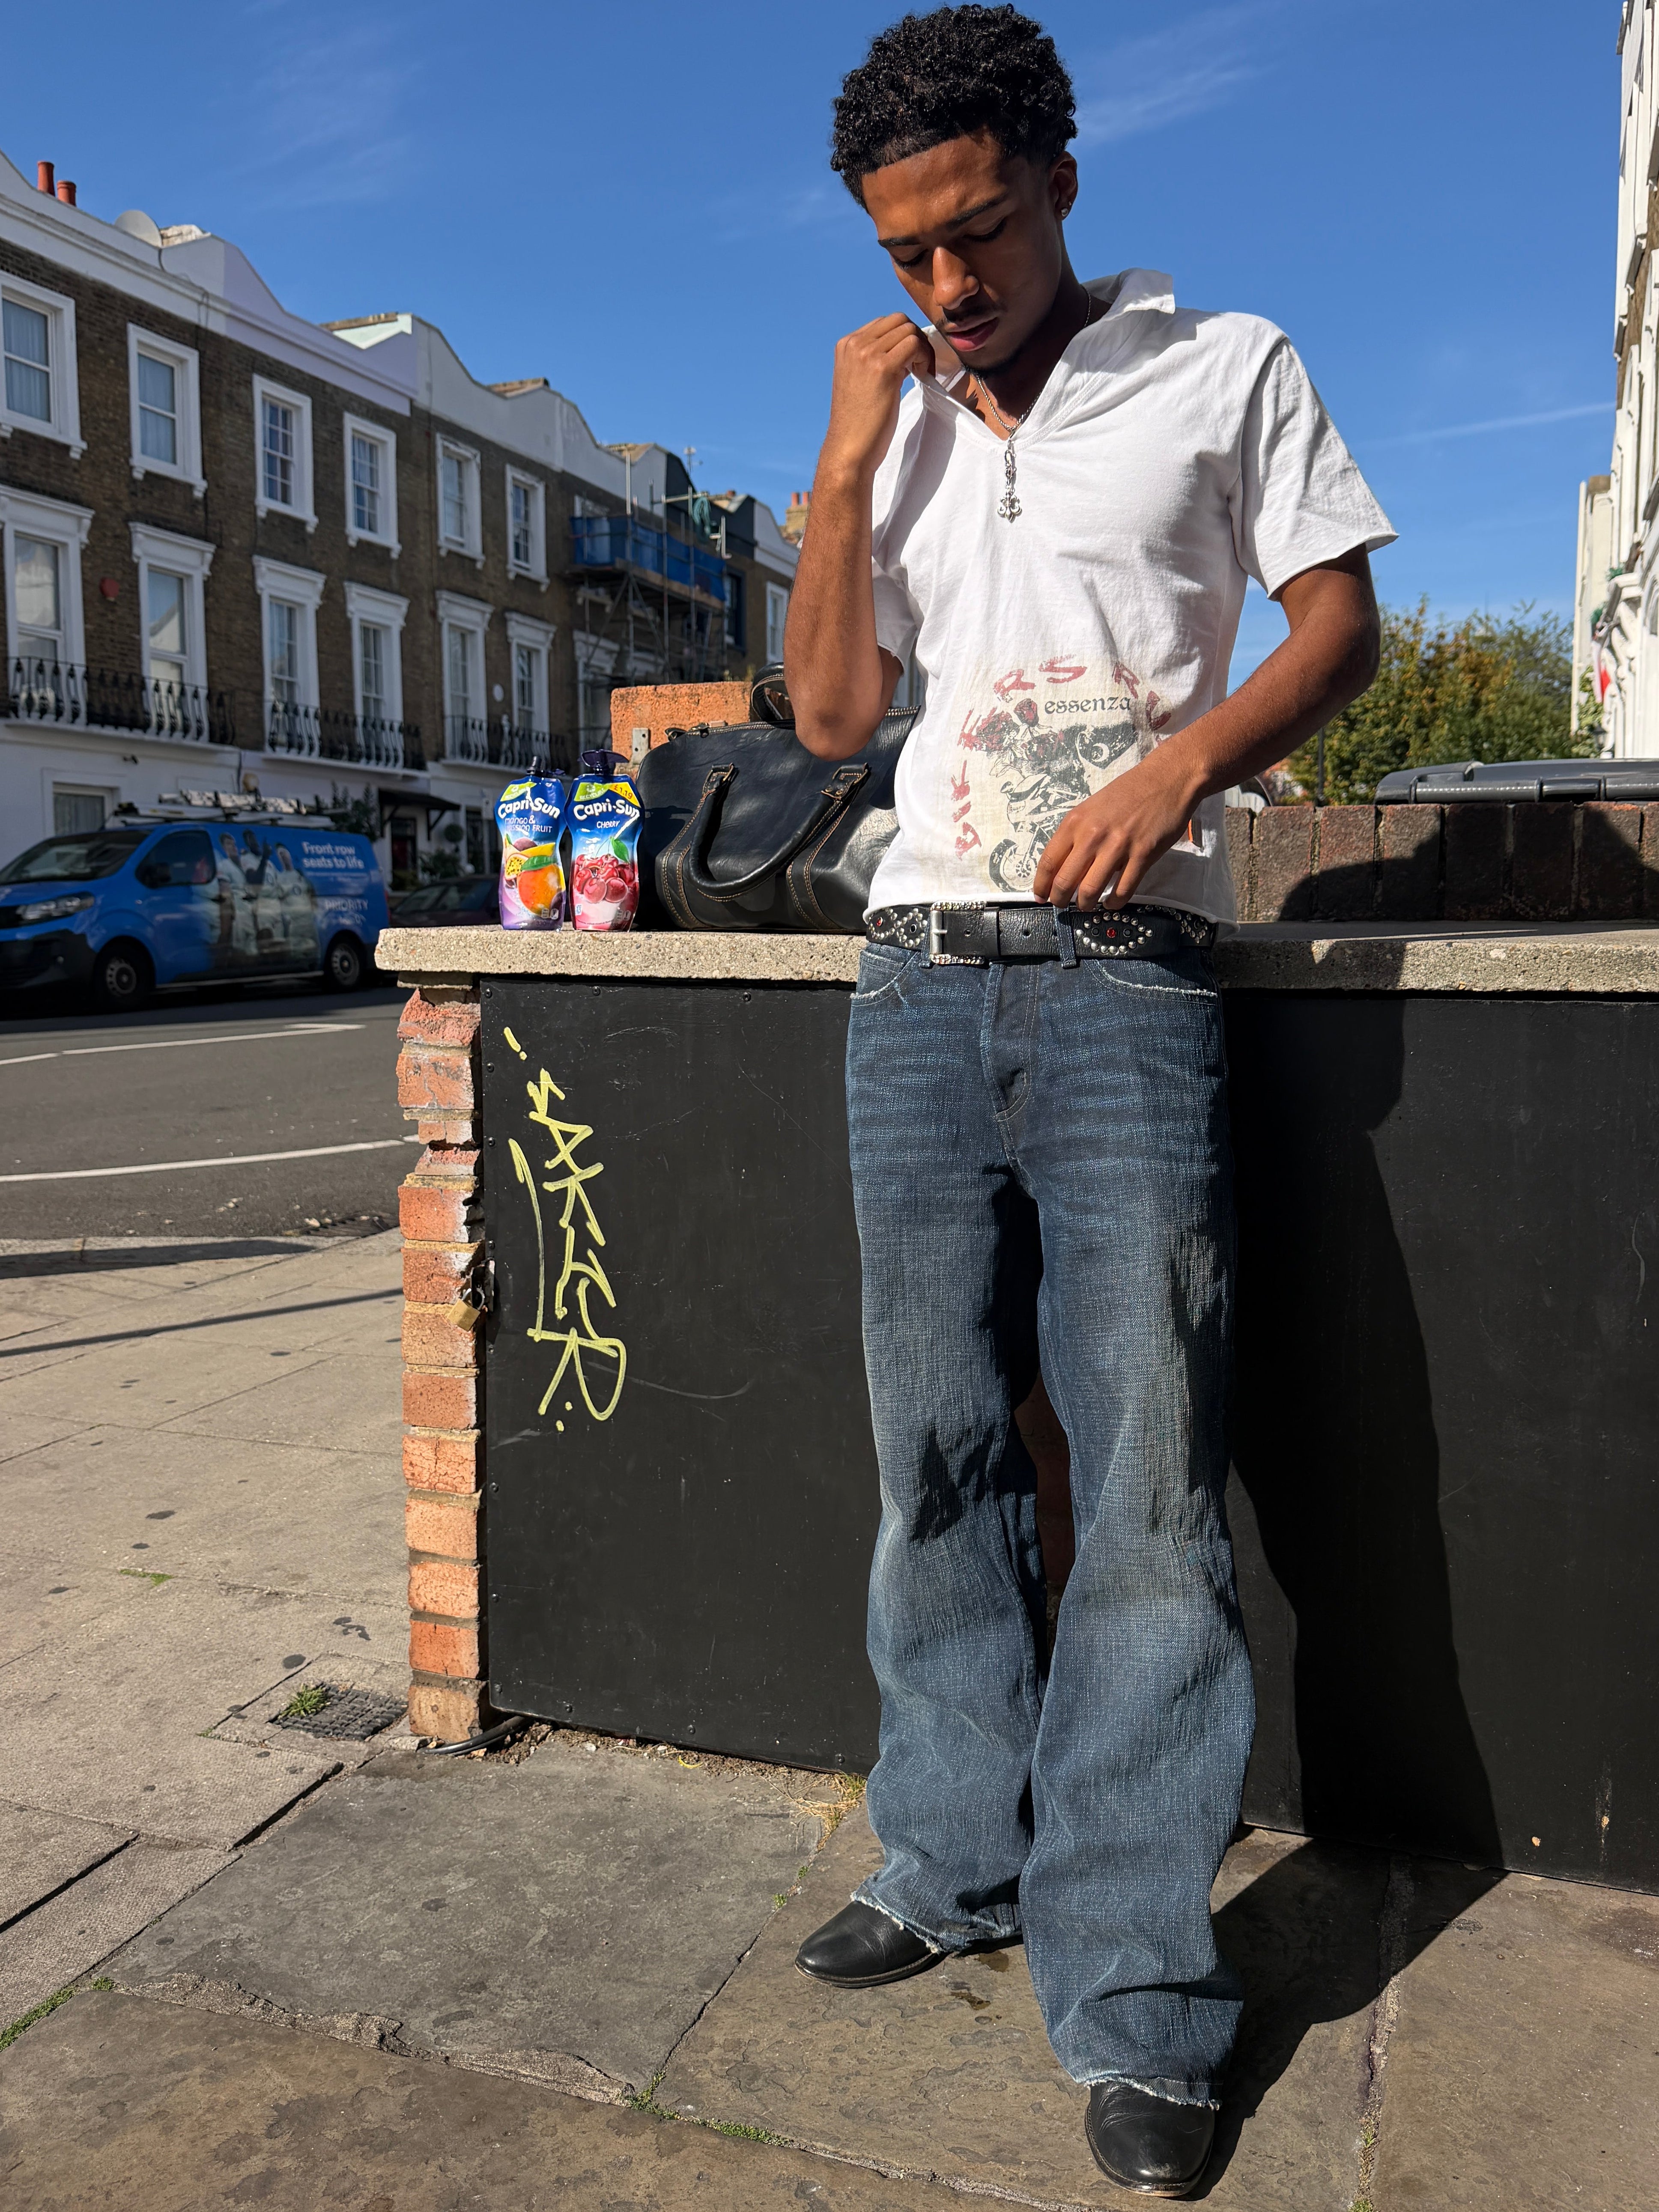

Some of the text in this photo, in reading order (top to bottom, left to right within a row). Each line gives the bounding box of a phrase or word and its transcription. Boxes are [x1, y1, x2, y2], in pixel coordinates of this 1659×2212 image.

[1044, 696, 1131, 714] essenza
[614, 784, 633, 799] £1.19
[573, 798, 640, 821] Capri-Sun
[528, 815, 535, 824] &
[532, 824, 552, 833] FRUIT
[302, 841, 355, 855] Front row
[302, 855, 364, 869] seats to life
